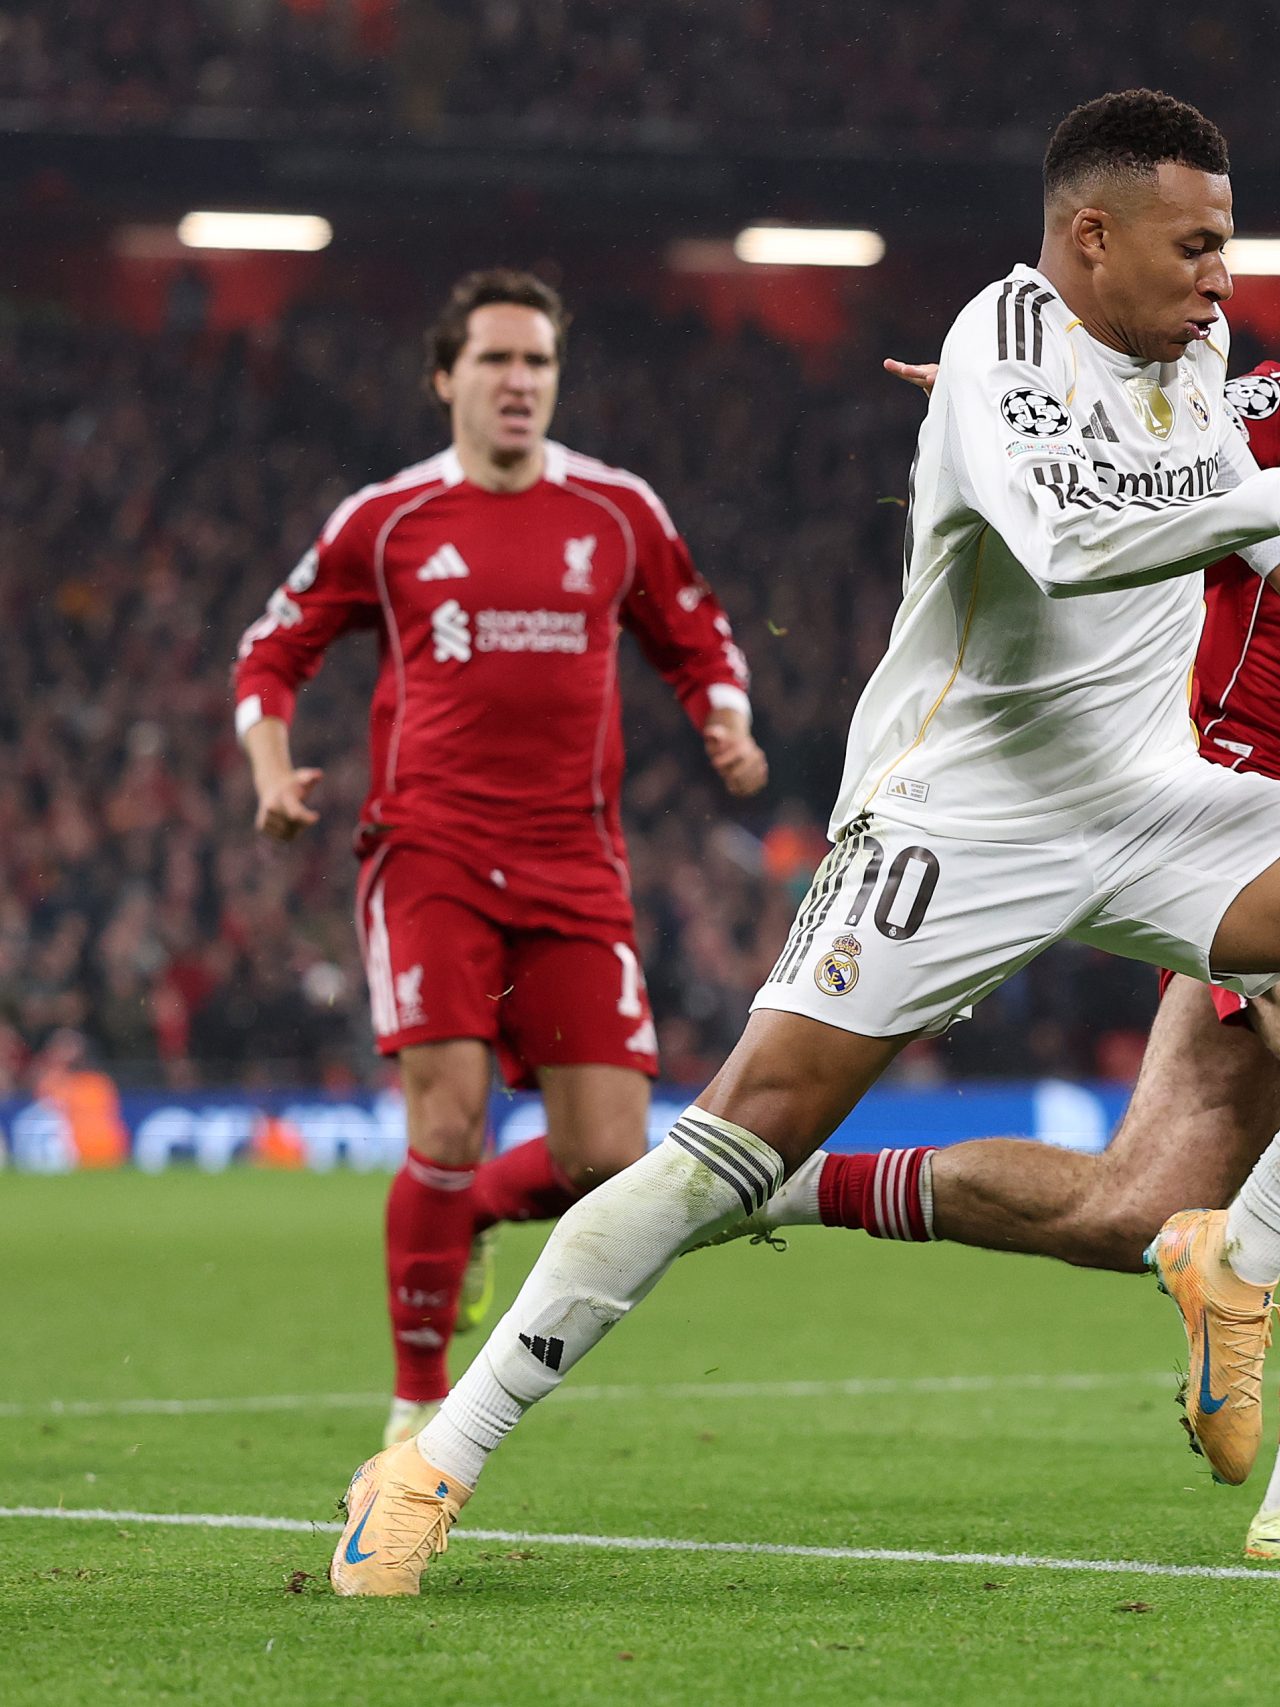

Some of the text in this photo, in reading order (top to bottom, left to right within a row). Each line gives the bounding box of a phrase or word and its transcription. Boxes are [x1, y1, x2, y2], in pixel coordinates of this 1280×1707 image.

[1018, 402, 1053, 426] 15
[844, 835, 941, 941] 10
[613, 941, 648, 1018] 1
